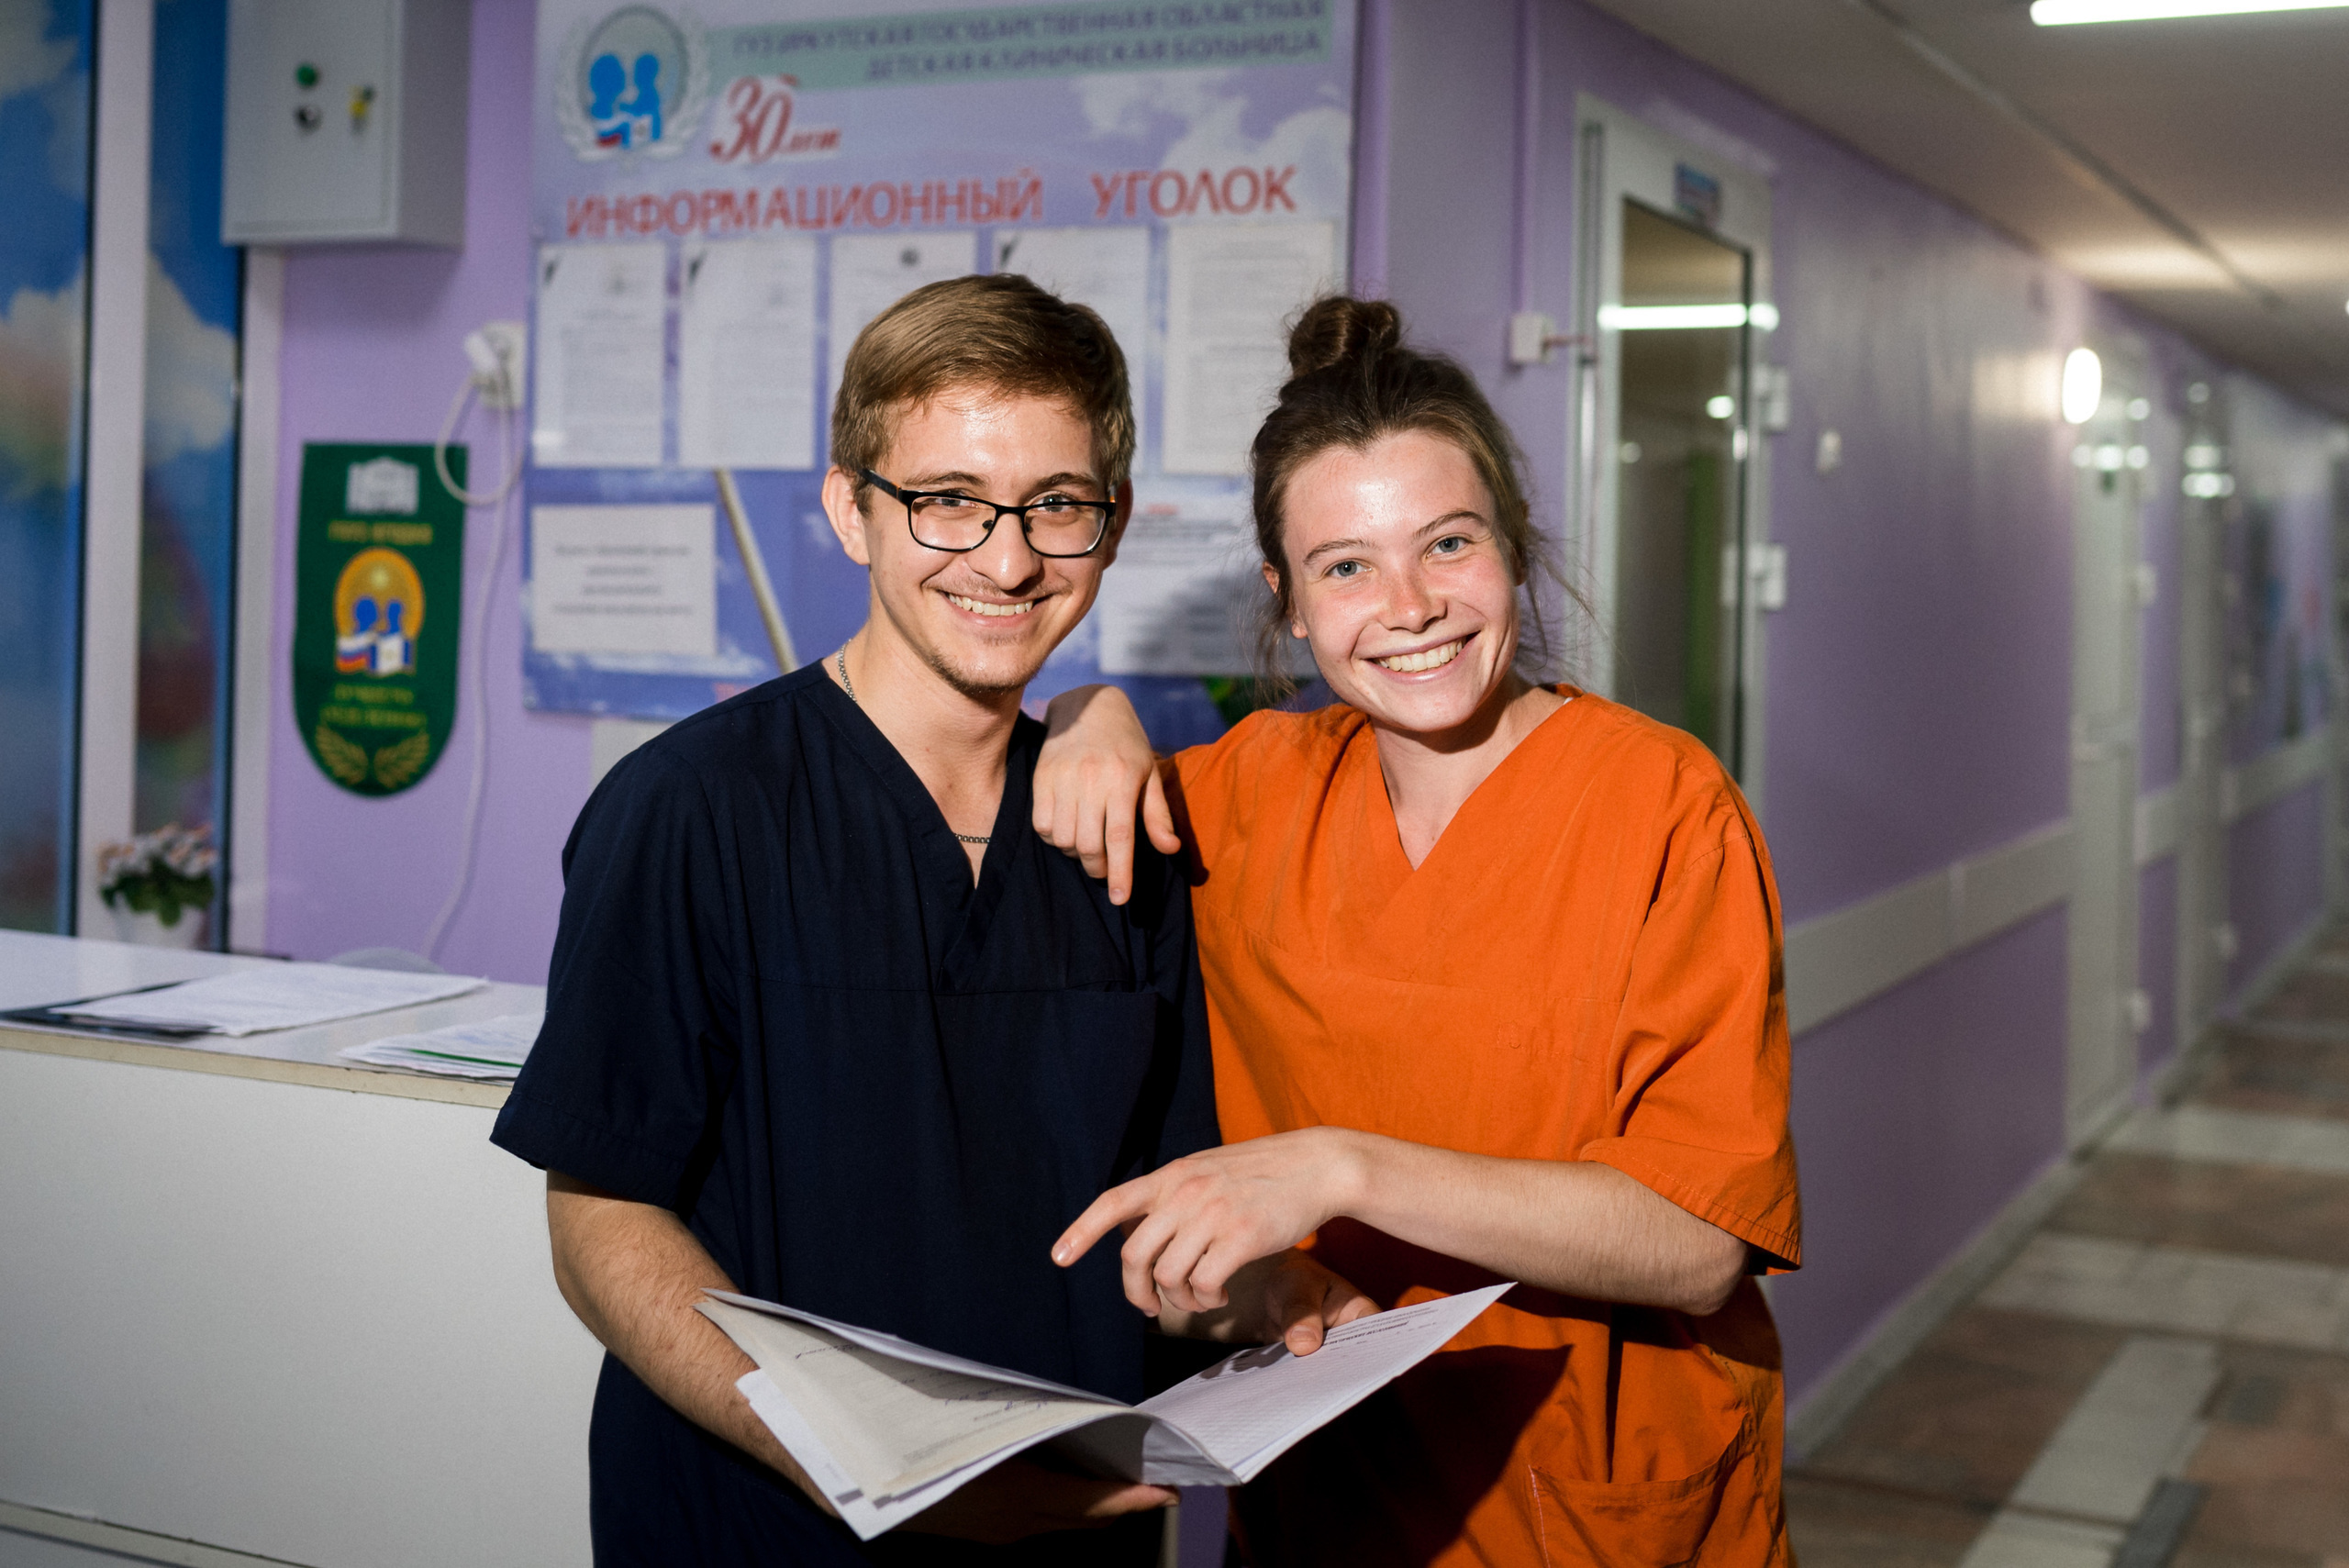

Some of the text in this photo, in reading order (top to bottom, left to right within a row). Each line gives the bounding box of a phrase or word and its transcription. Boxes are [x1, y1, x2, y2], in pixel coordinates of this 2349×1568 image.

[1163, 0, 1323, 28] ОБЛАСТНАЯ
[866, 29, 1319, 79] ДЕТСКАЯ КЛИНИЧЕСКАЯ БОЛЬНИЦА
[710, 75, 795, 163] 30
[566, 165, 1296, 238] ИНФОРМАЦИОННЫЙ УГОЛОК
